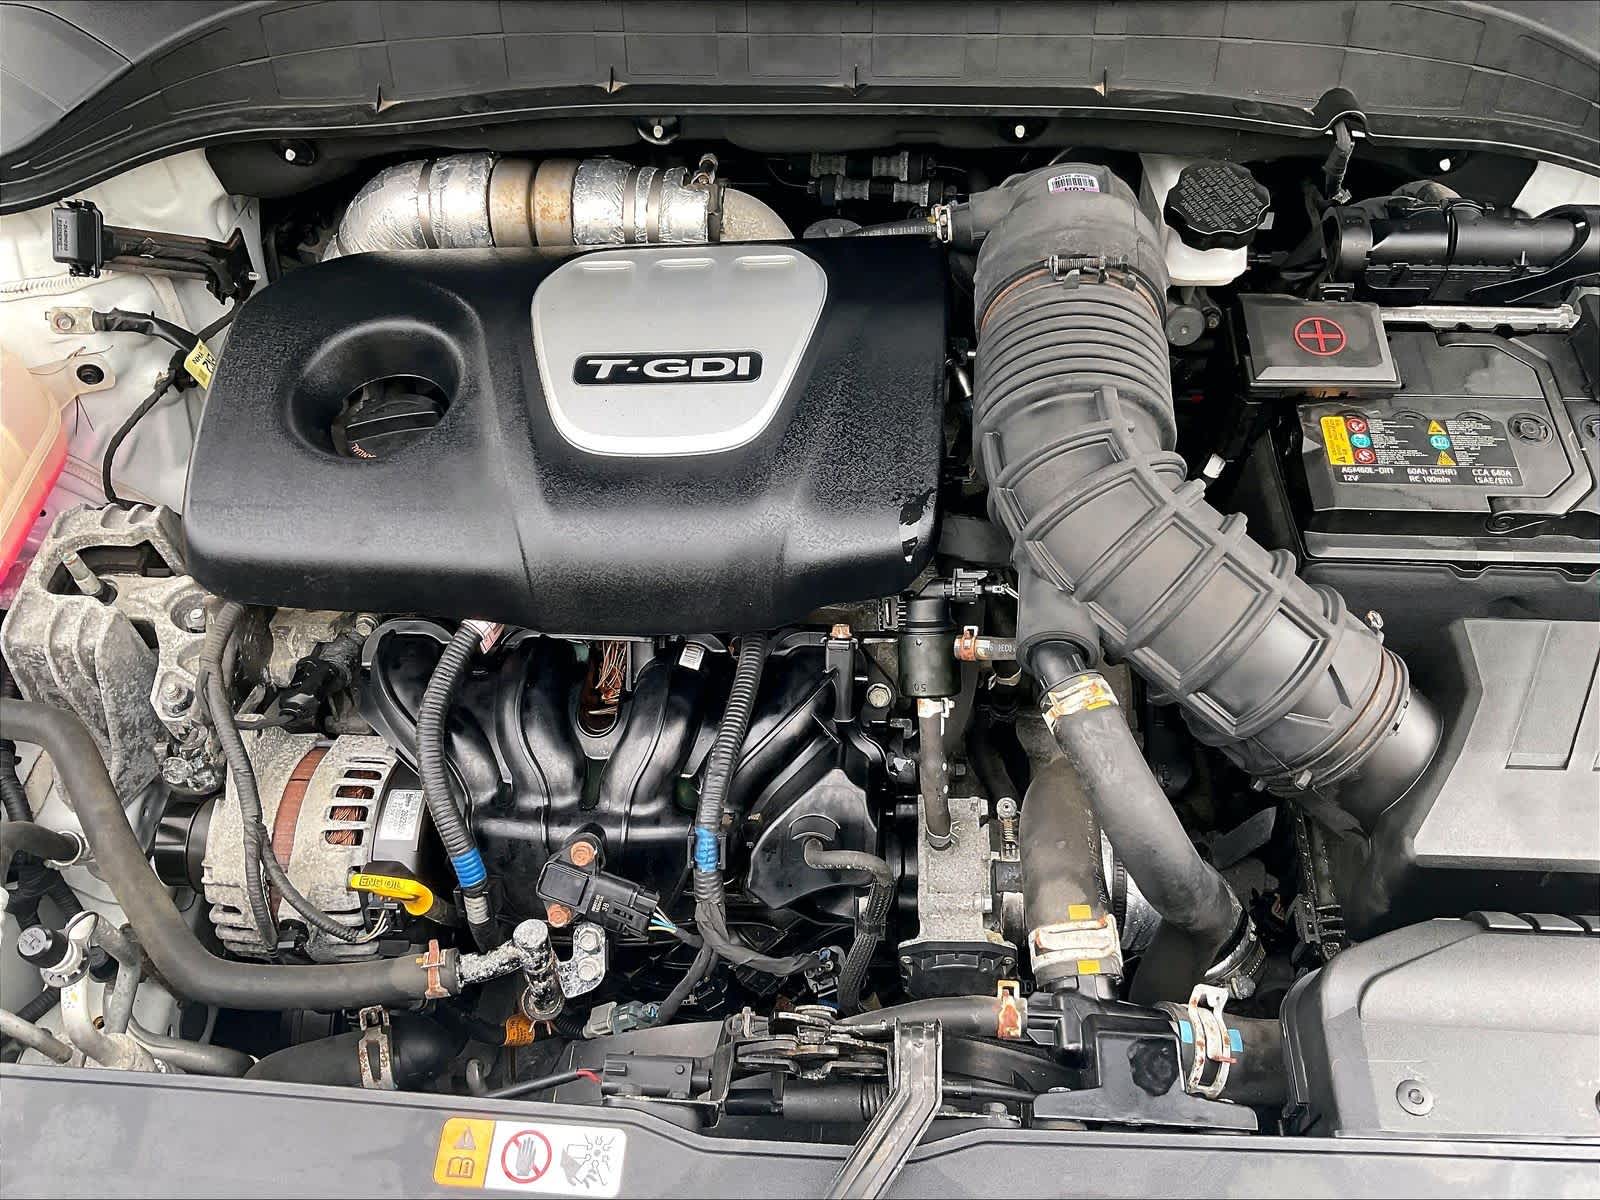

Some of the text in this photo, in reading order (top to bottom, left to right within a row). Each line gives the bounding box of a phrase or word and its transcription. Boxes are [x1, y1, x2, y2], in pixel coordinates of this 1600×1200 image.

[587, 356, 751, 379] T-GDI
[1407, 467, 1428, 475] 60Ah
[1472, 468, 1489, 476] CCA
[359, 875, 401, 889] ENG OIL
